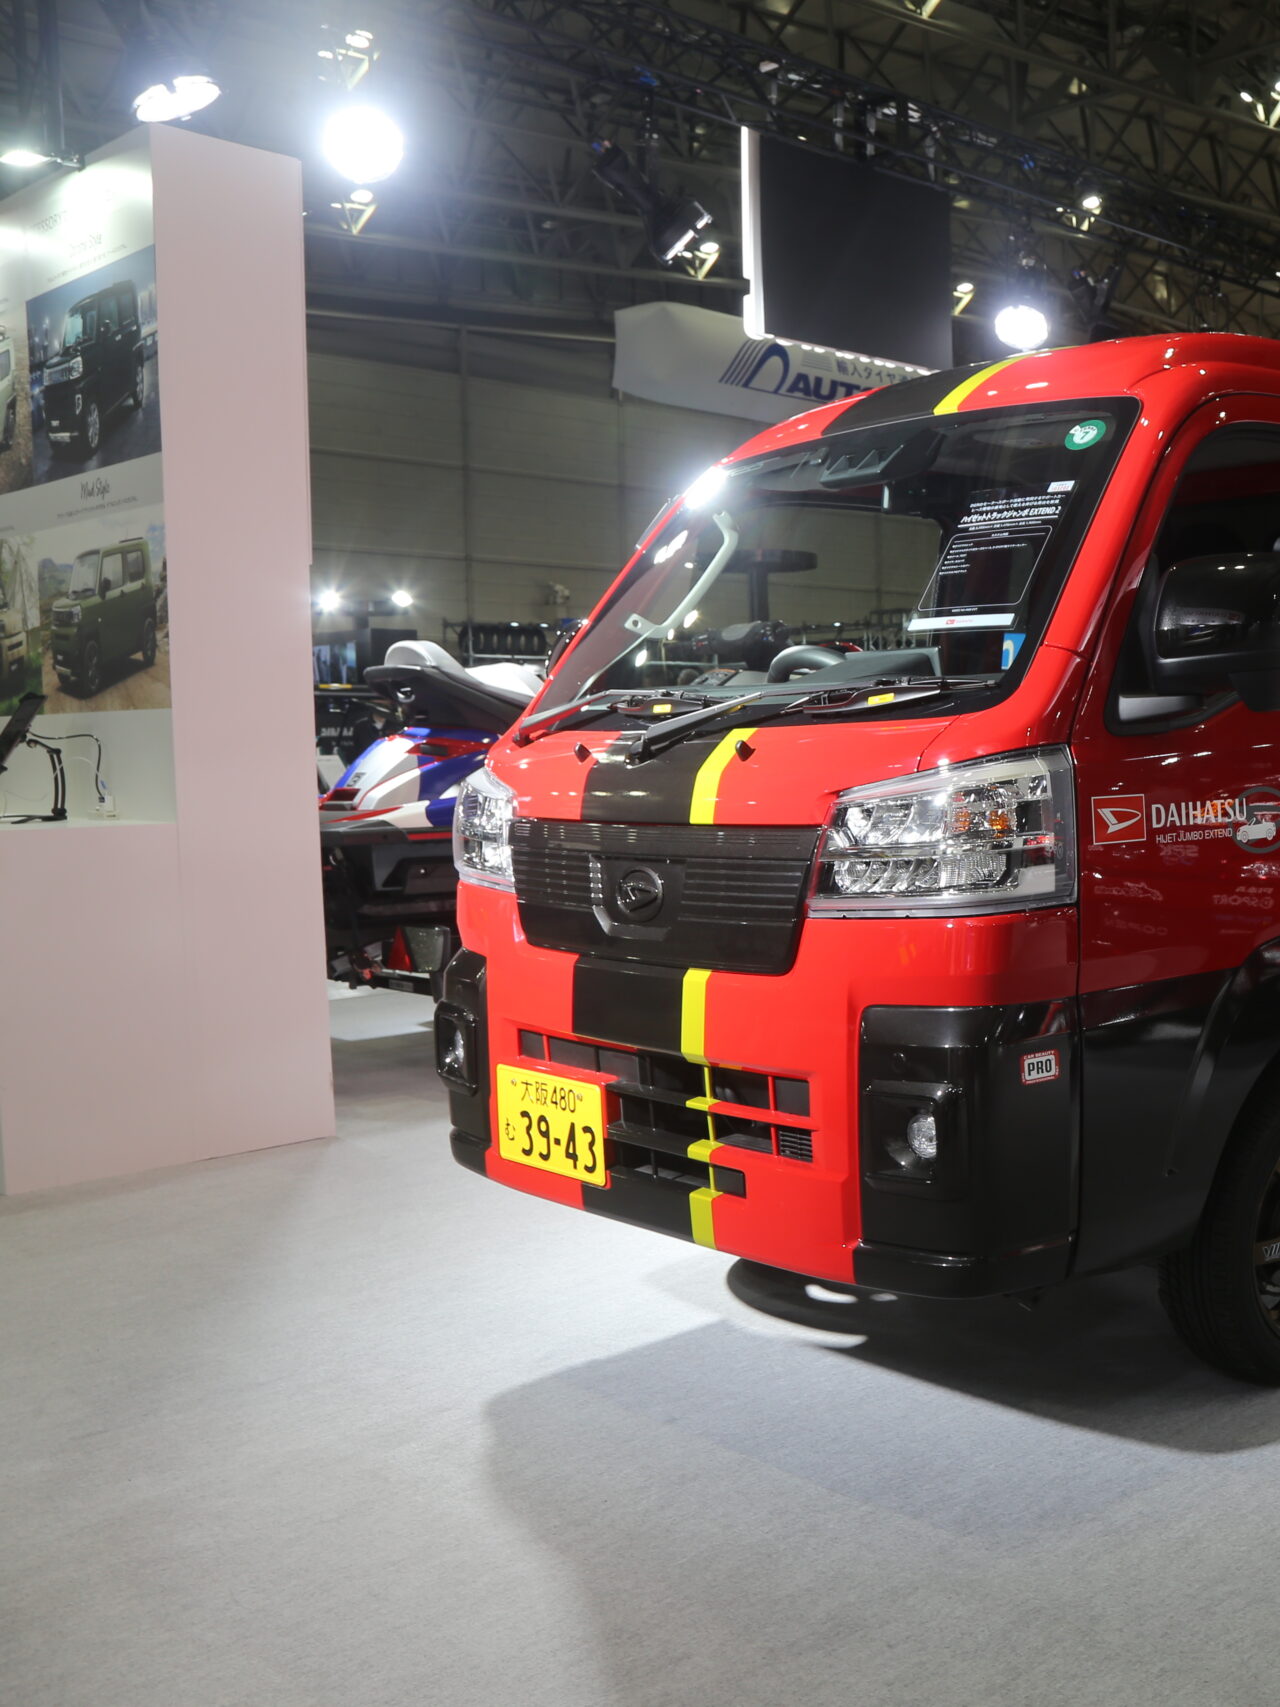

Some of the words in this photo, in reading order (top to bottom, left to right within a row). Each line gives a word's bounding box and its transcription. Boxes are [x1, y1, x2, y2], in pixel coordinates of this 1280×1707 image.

[1029, 507, 1057, 517] EXTEND
[1151, 797, 1247, 828] DAIHATSU
[1155, 832, 1178, 844] HIJET
[1204, 827, 1233, 840] EXTEND
[1027, 1058, 1053, 1077] PRO
[504, 1117, 516, 1141] む
[519, 1110, 597, 1174] 39-43
